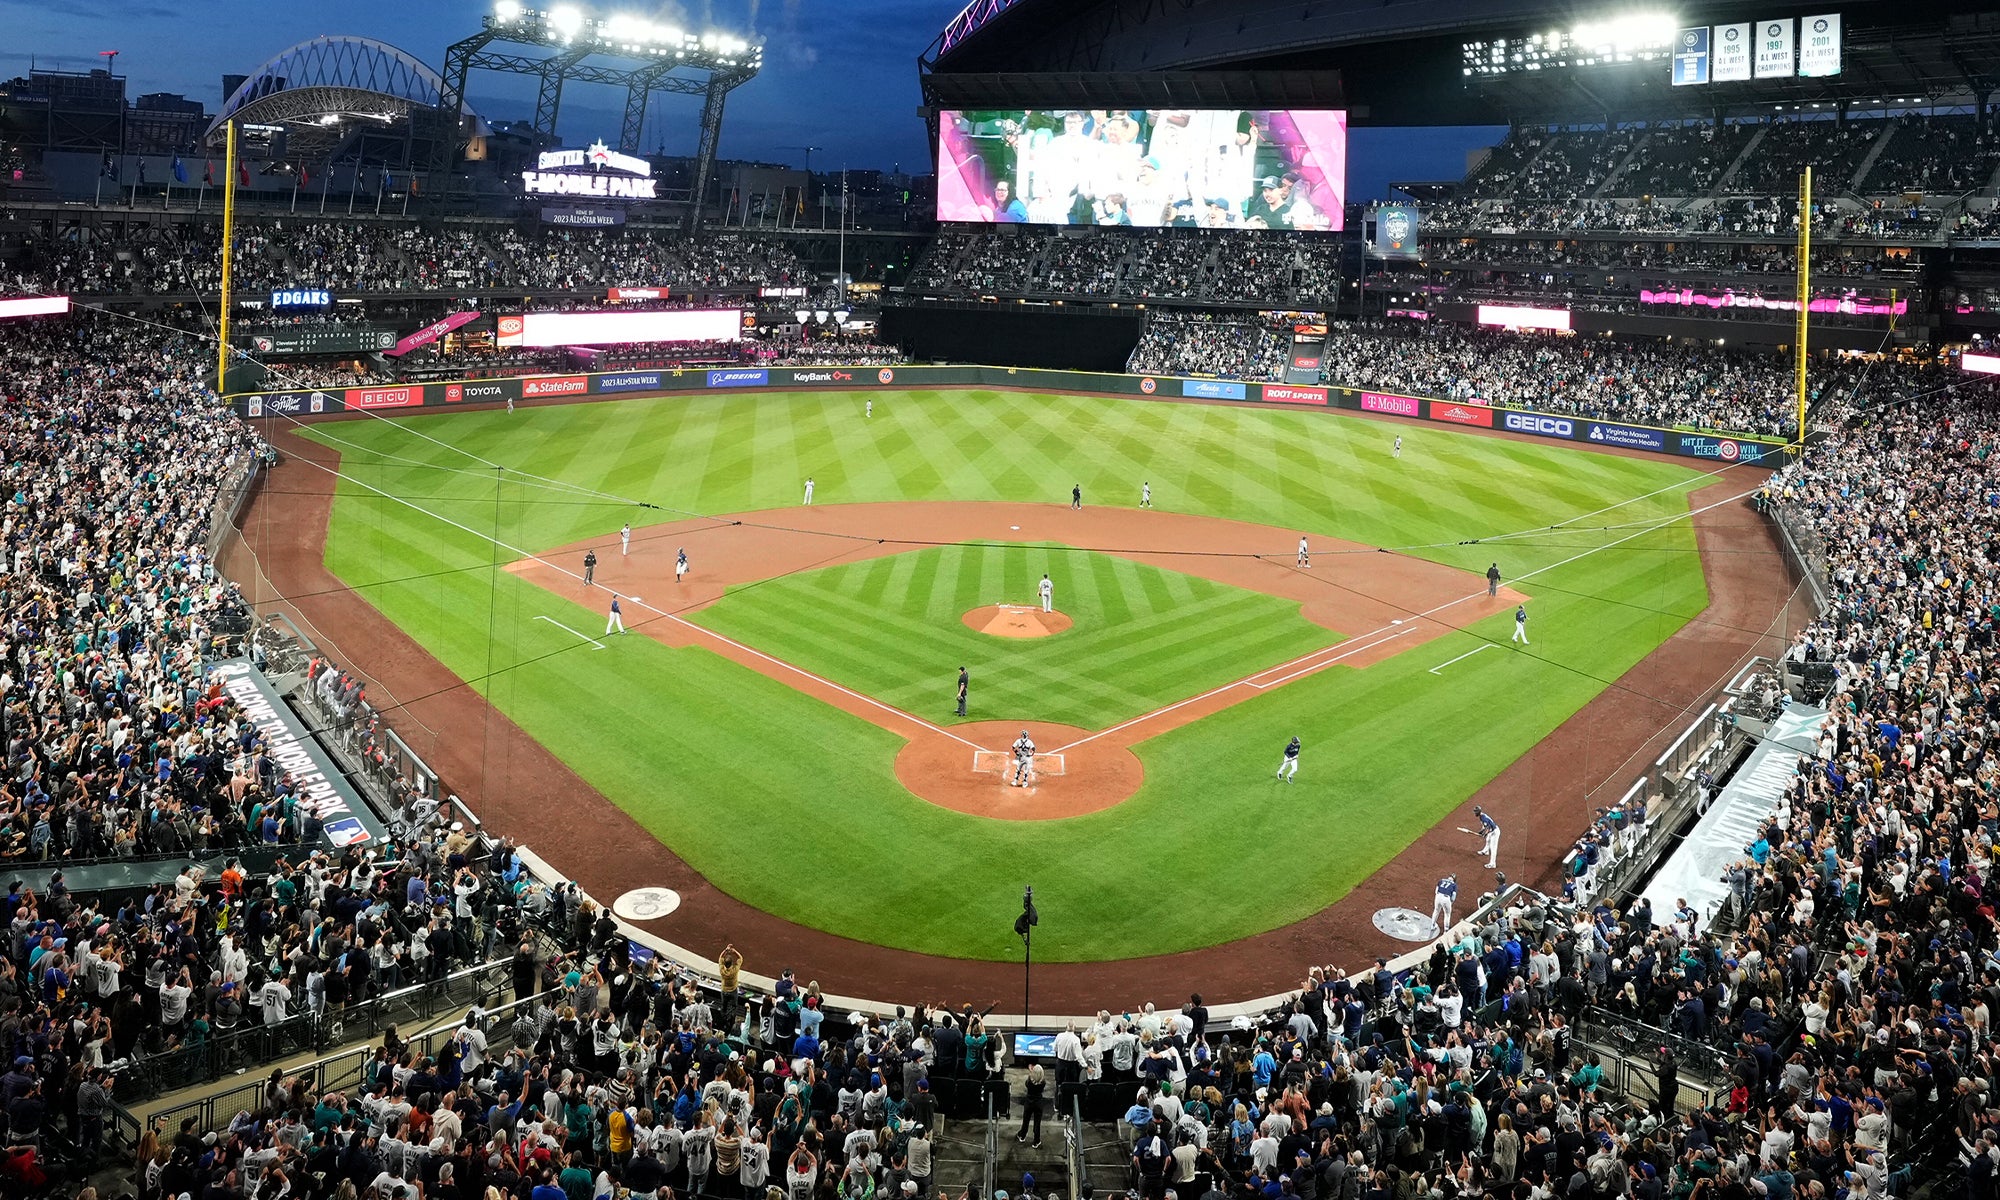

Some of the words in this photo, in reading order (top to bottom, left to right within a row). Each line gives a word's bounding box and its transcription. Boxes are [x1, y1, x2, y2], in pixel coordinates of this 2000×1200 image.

[1767, 41, 1783, 51] 1997
[1812, 37, 1830, 47] 2001
[1724, 45, 1741, 55] 1995
[1817, 49, 1834, 57] WEST
[1729, 56, 1745, 64] WEST
[1771, 52, 1788, 60] WEST
[1757, 62, 1791, 73] CHAMPIONS
[609, 177, 657, 199] PARK
[554, 215, 569, 224] 2023
[597, 215, 614, 225] WEEK
[794, 372, 832, 383] KeyBank
[881, 372, 891, 380] 76
[602, 378, 616, 387] 2023
[641, 376, 658, 385] WEEK
[1142, 381, 1155, 391] 76
[465, 386, 502, 396] TOYOTA
[1267, 389, 1291, 399] ROOT
[365, 392, 406, 404] BECU
[1506, 414, 1572, 436] GEICO
[1605, 427, 1629, 438] Virginia
[1629, 430, 1650, 439] Mason
[1605, 435, 1638, 444] Franciscan
[1638, 438, 1660, 448] Health
[1681, 437, 1695, 447] HIT
[1694, 438, 1705, 447] IT
[1695, 446, 1718, 456] HERE
[1740, 445, 1757, 454] WIN
[266, 996, 276, 1007] 51
[596, 1031, 606, 1044] 18
